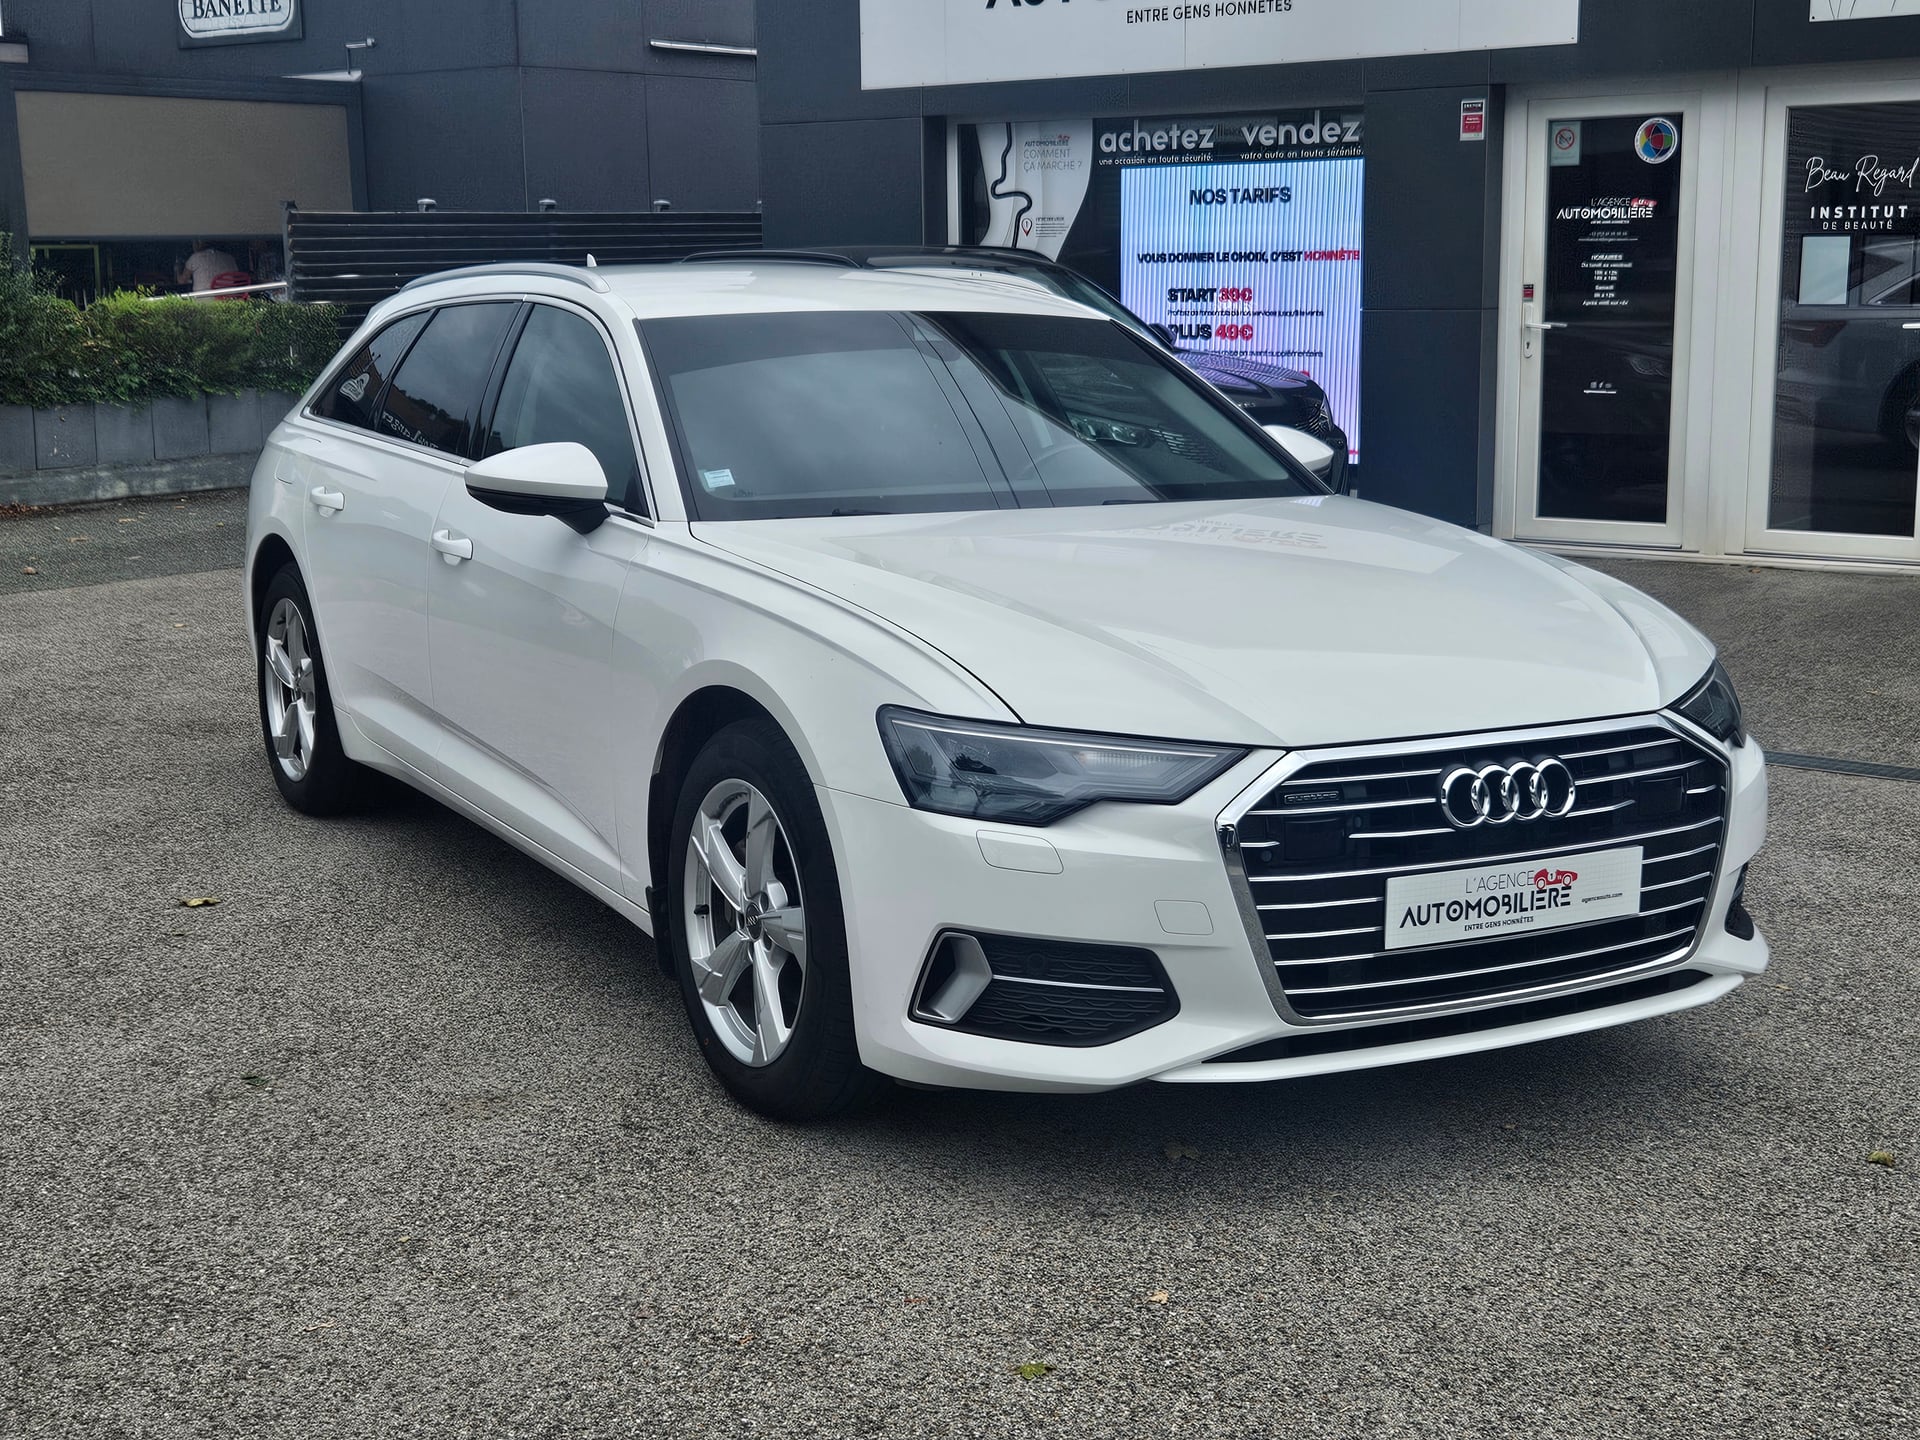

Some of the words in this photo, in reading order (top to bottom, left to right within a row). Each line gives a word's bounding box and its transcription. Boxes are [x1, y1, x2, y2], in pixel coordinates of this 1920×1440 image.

[1126, 7, 1169, 24] ENTRE
[1173, 4, 1211, 20] GENS
[1241, 110, 1360, 146] vendez
[1099, 119, 1215, 153] achetez
[1023, 147, 1071, 159] COMMENT
[1240, 152, 1262, 160] votre
[1264, 150, 1285, 159] auto
[1301, 149, 1324, 158] toute
[1023, 160, 1036, 173] ÇA
[1037, 160, 1075, 171] MARCHE
[1114, 156, 1146, 165] occasion
[1160, 155, 1179, 164] toute
[1804, 156, 1850, 193] Beau
[1855, 154, 1920, 197] Regard
[1190, 188, 1227, 205] NOS
[1230, 186, 1292, 204] TARIFS
[1590, 197, 1631, 207] L'AGENCE
[1810, 205, 1908, 219] INSTITUT
[1822, 221, 1838, 230] DE
[1137, 252, 1167, 264] VOUS
[1168, 252, 1215, 263] DONNER
[1216, 251, 1230, 262] LE
[1167, 287, 1217, 302] START
[1465, 869, 1535, 894] L'AGENCE
[1464, 922, 1484, 931] ENTRE
[1484, 920, 1501, 929] GENS
